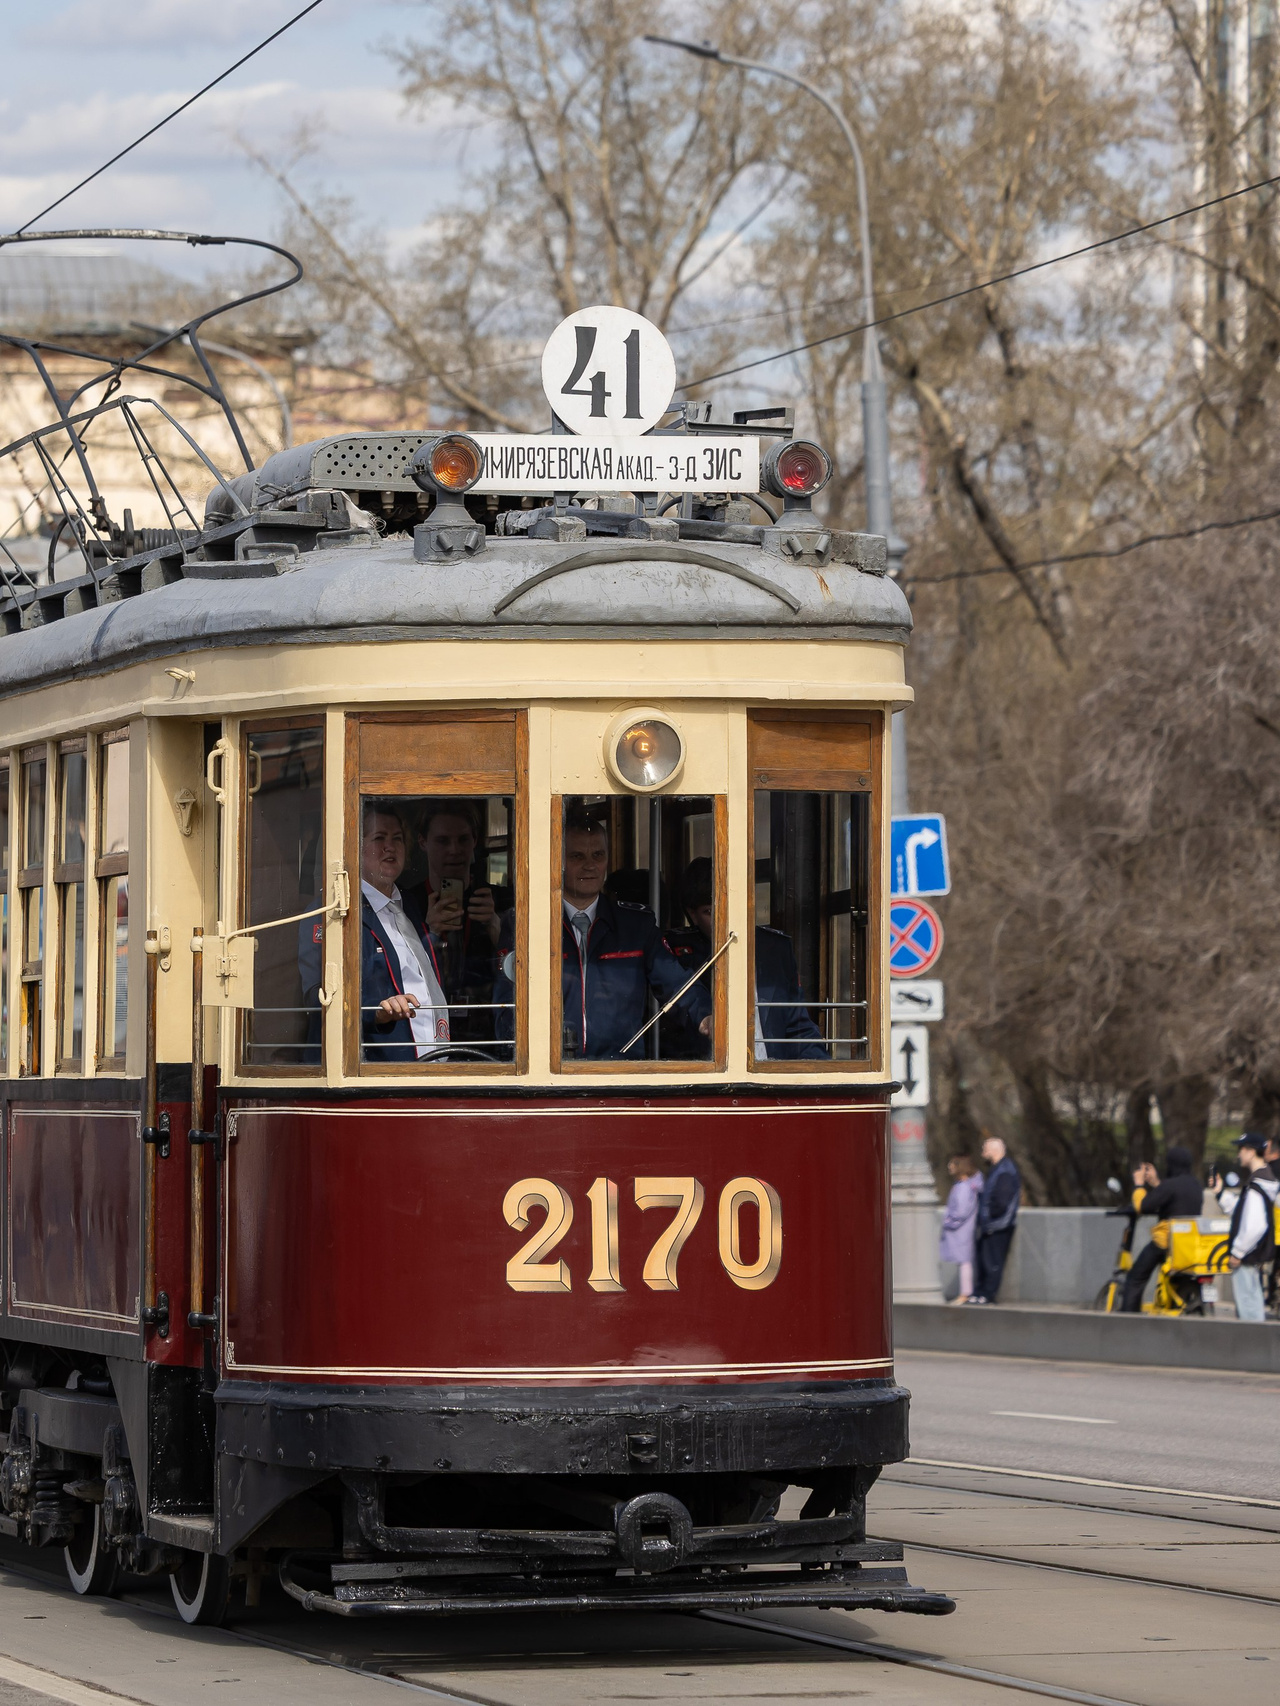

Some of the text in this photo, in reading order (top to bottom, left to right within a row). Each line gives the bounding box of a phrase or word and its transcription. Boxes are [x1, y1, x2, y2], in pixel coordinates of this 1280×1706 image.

[560, 325, 644, 420] 41
[702, 447, 742, 481] ЗИС
[502, 1176, 783, 1293] 2170
